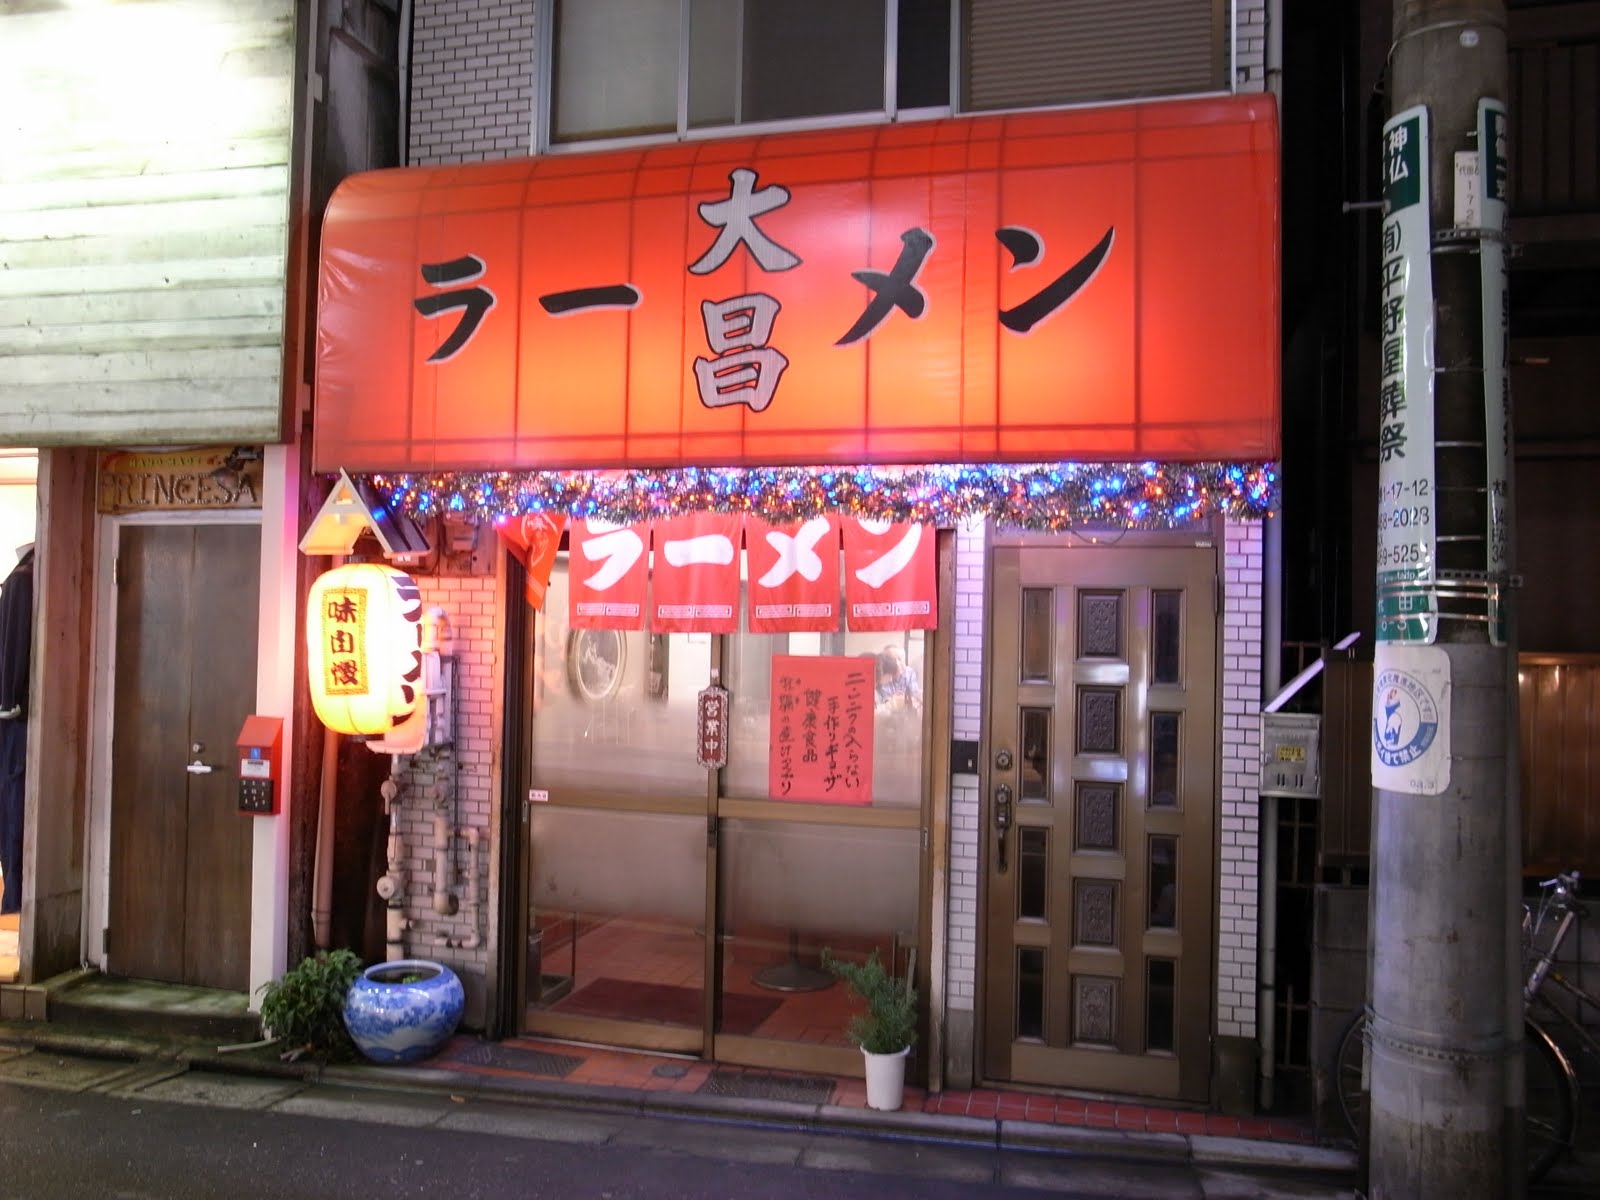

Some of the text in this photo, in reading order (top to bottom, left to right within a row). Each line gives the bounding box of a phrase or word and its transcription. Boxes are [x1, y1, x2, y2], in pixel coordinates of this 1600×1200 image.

[688, 167, 804, 413] 大昌
[582, 516, 923, 591] ラーメン
[327, 595, 360, 687] 味自慢
[704, 699, 720, 757] 営業中
